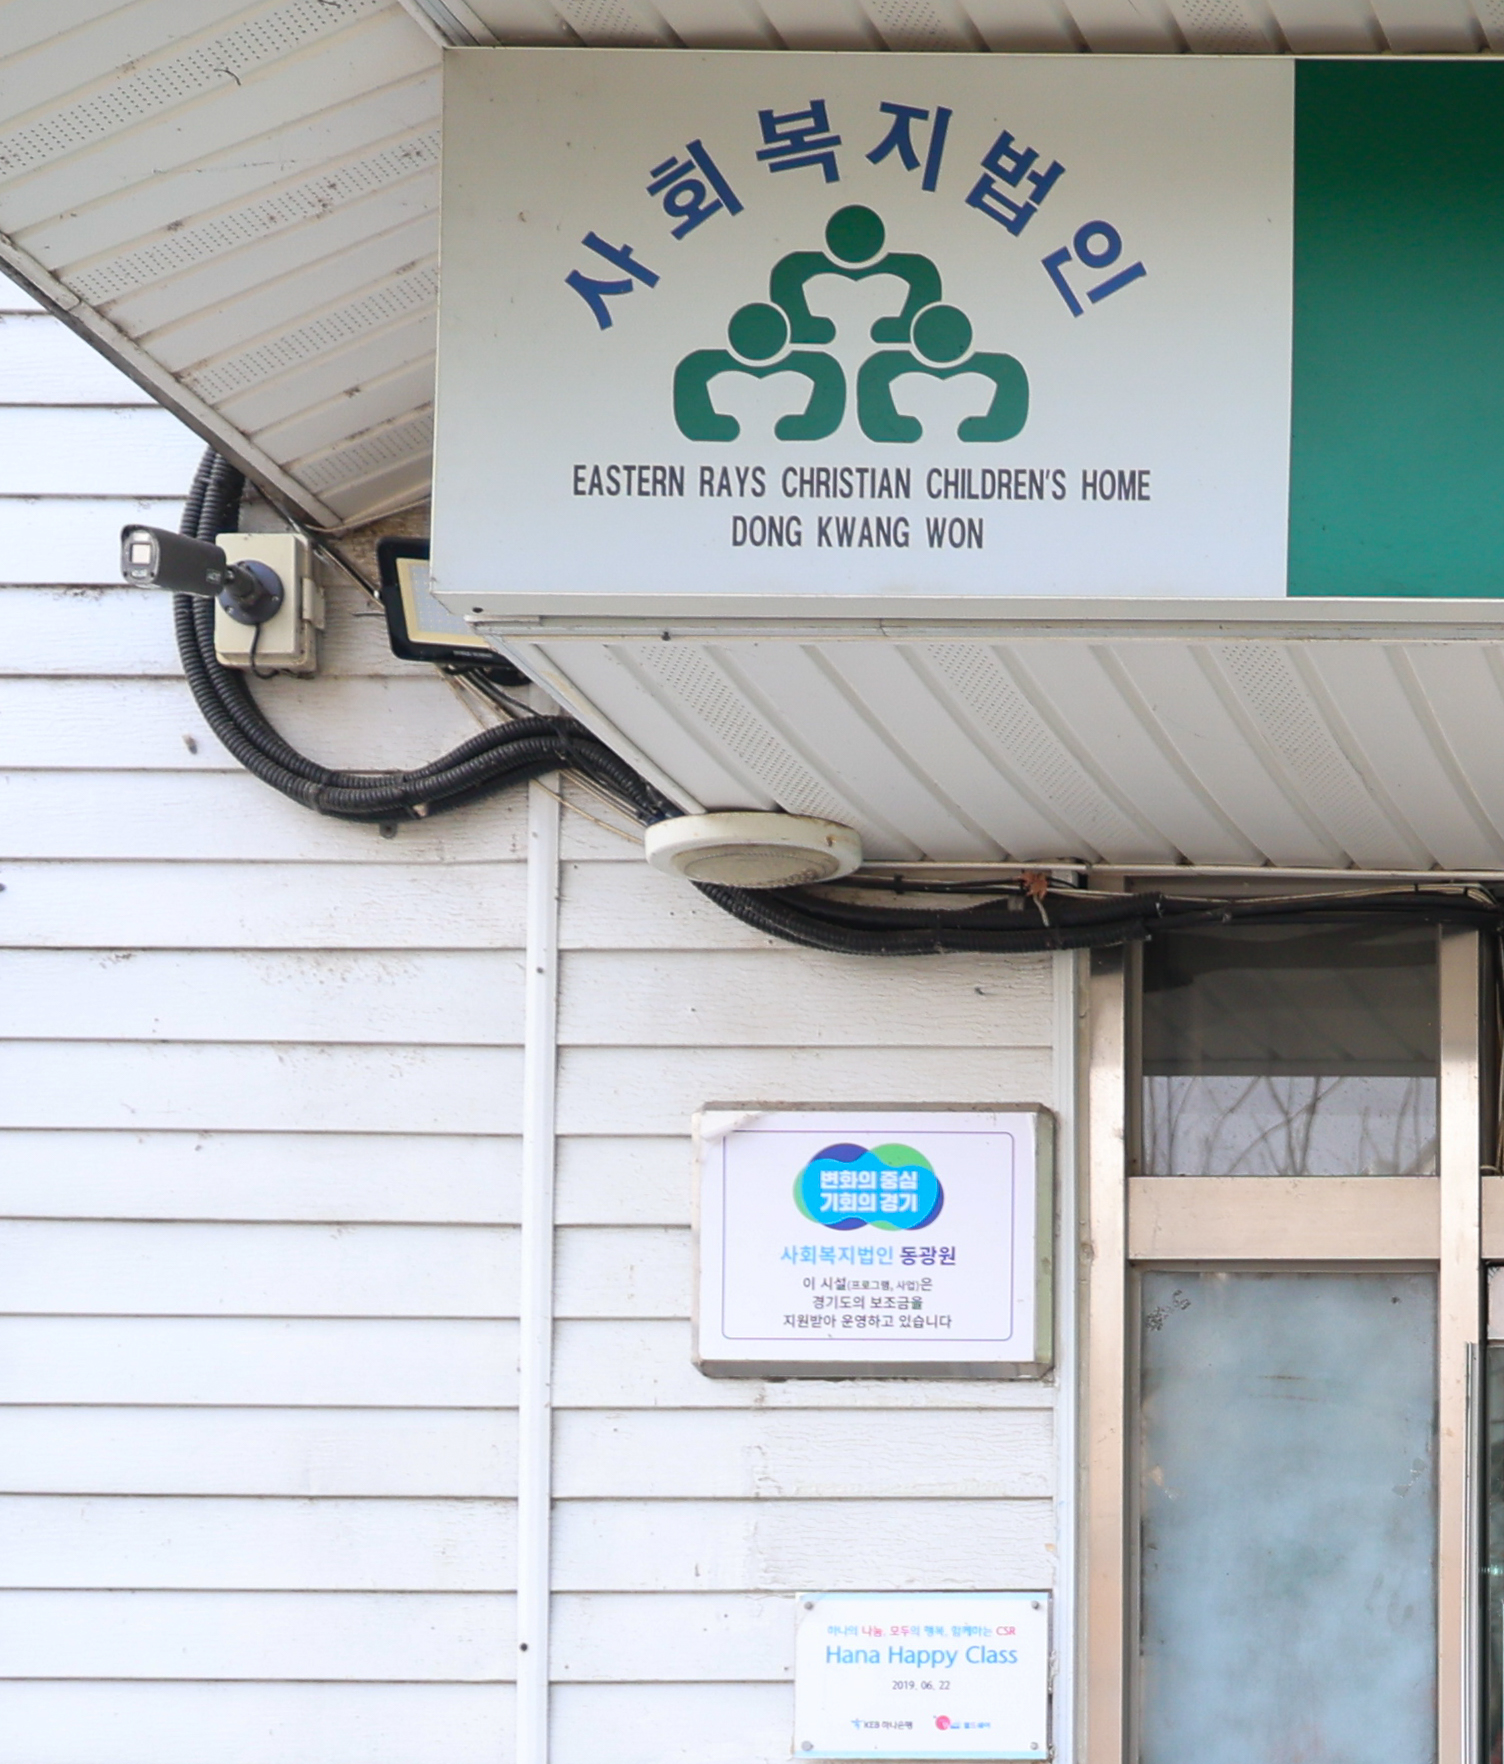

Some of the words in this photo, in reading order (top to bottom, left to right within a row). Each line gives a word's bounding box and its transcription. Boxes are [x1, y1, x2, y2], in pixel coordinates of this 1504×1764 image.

[564, 99, 1147, 330] 사회복지법인
[574, 465, 684, 496] EASTERN
[700, 466, 765, 497] RAYS
[782, 467, 910, 499] CHRISTIAN
[927, 468, 1066, 500] CHILDREN'S
[1082, 470, 1150, 501] HOME
[732, 515, 801, 547] DONG
[818, 516, 909, 548] KWANG
[926, 517, 983, 549] WON
[821, 1170, 876, 1189] 변화의
[880, 1170, 918, 1189] 중심
[820, 1192, 876, 1212] 기회의
[880, 1192, 918, 1212] 경기
[781, 1245, 893, 1265] 사회복지법인
[900, 1246, 955, 1265] 동광원
[802, 1277, 816, 1291] 이
[813, 1295, 865, 1309] 경기도의
[871, 1296, 923, 1310] 보조금을
[784, 1314, 837, 1328] 지원받아
[841, 1314, 894, 1328] 운영하고
[899, 1315, 952, 1328] 있습니다
[826, 1646, 880, 1663] Hana
[889, 1646, 957, 1668] Happy
[965, 1645, 1017, 1664] Class
